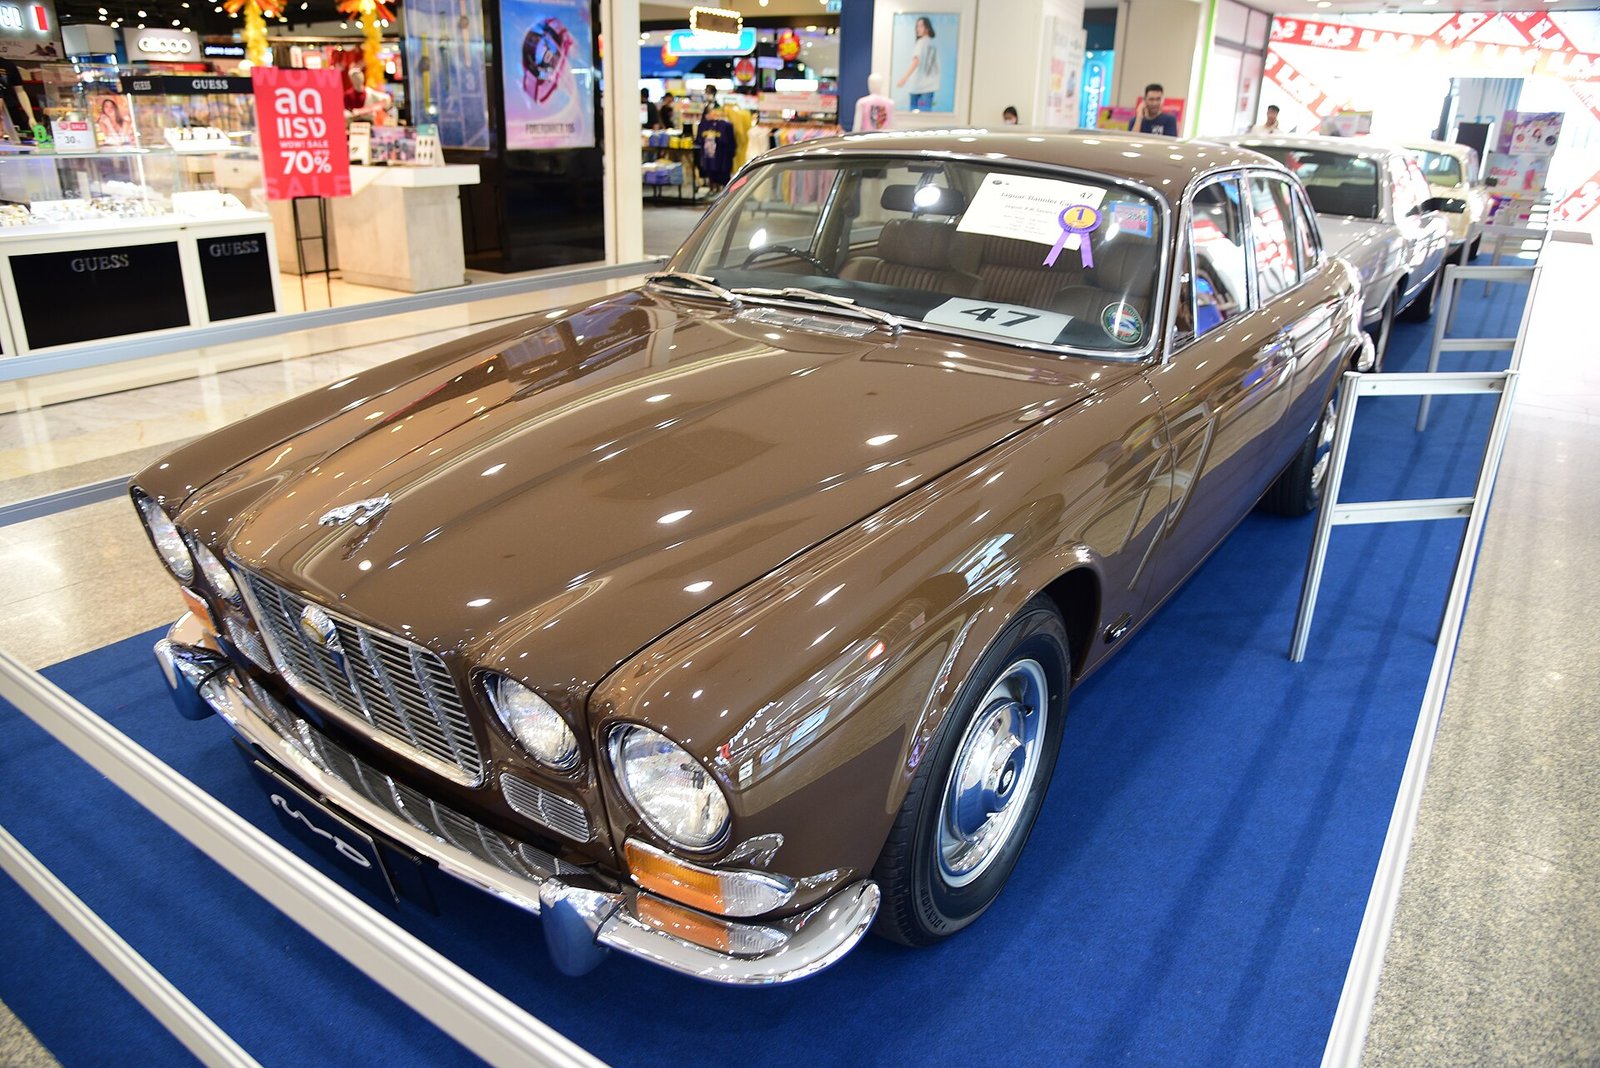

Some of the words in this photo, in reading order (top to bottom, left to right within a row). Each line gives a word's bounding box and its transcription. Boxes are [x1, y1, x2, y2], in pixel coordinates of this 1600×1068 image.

[192, 79, 229, 90] GUESS
[274, 87, 323, 115] ลด
[276, 117, 327, 139] แรง
[307, 140, 329, 149] SALE
[265, 175, 352, 201] SALE
[1080, 191, 1094, 200] 47
[1075, 208, 1085, 221] 1
[209, 240, 260, 257] GUESS
[71, 254, 130, 273] GUESS
[960, 306, 1041, 327] 47
